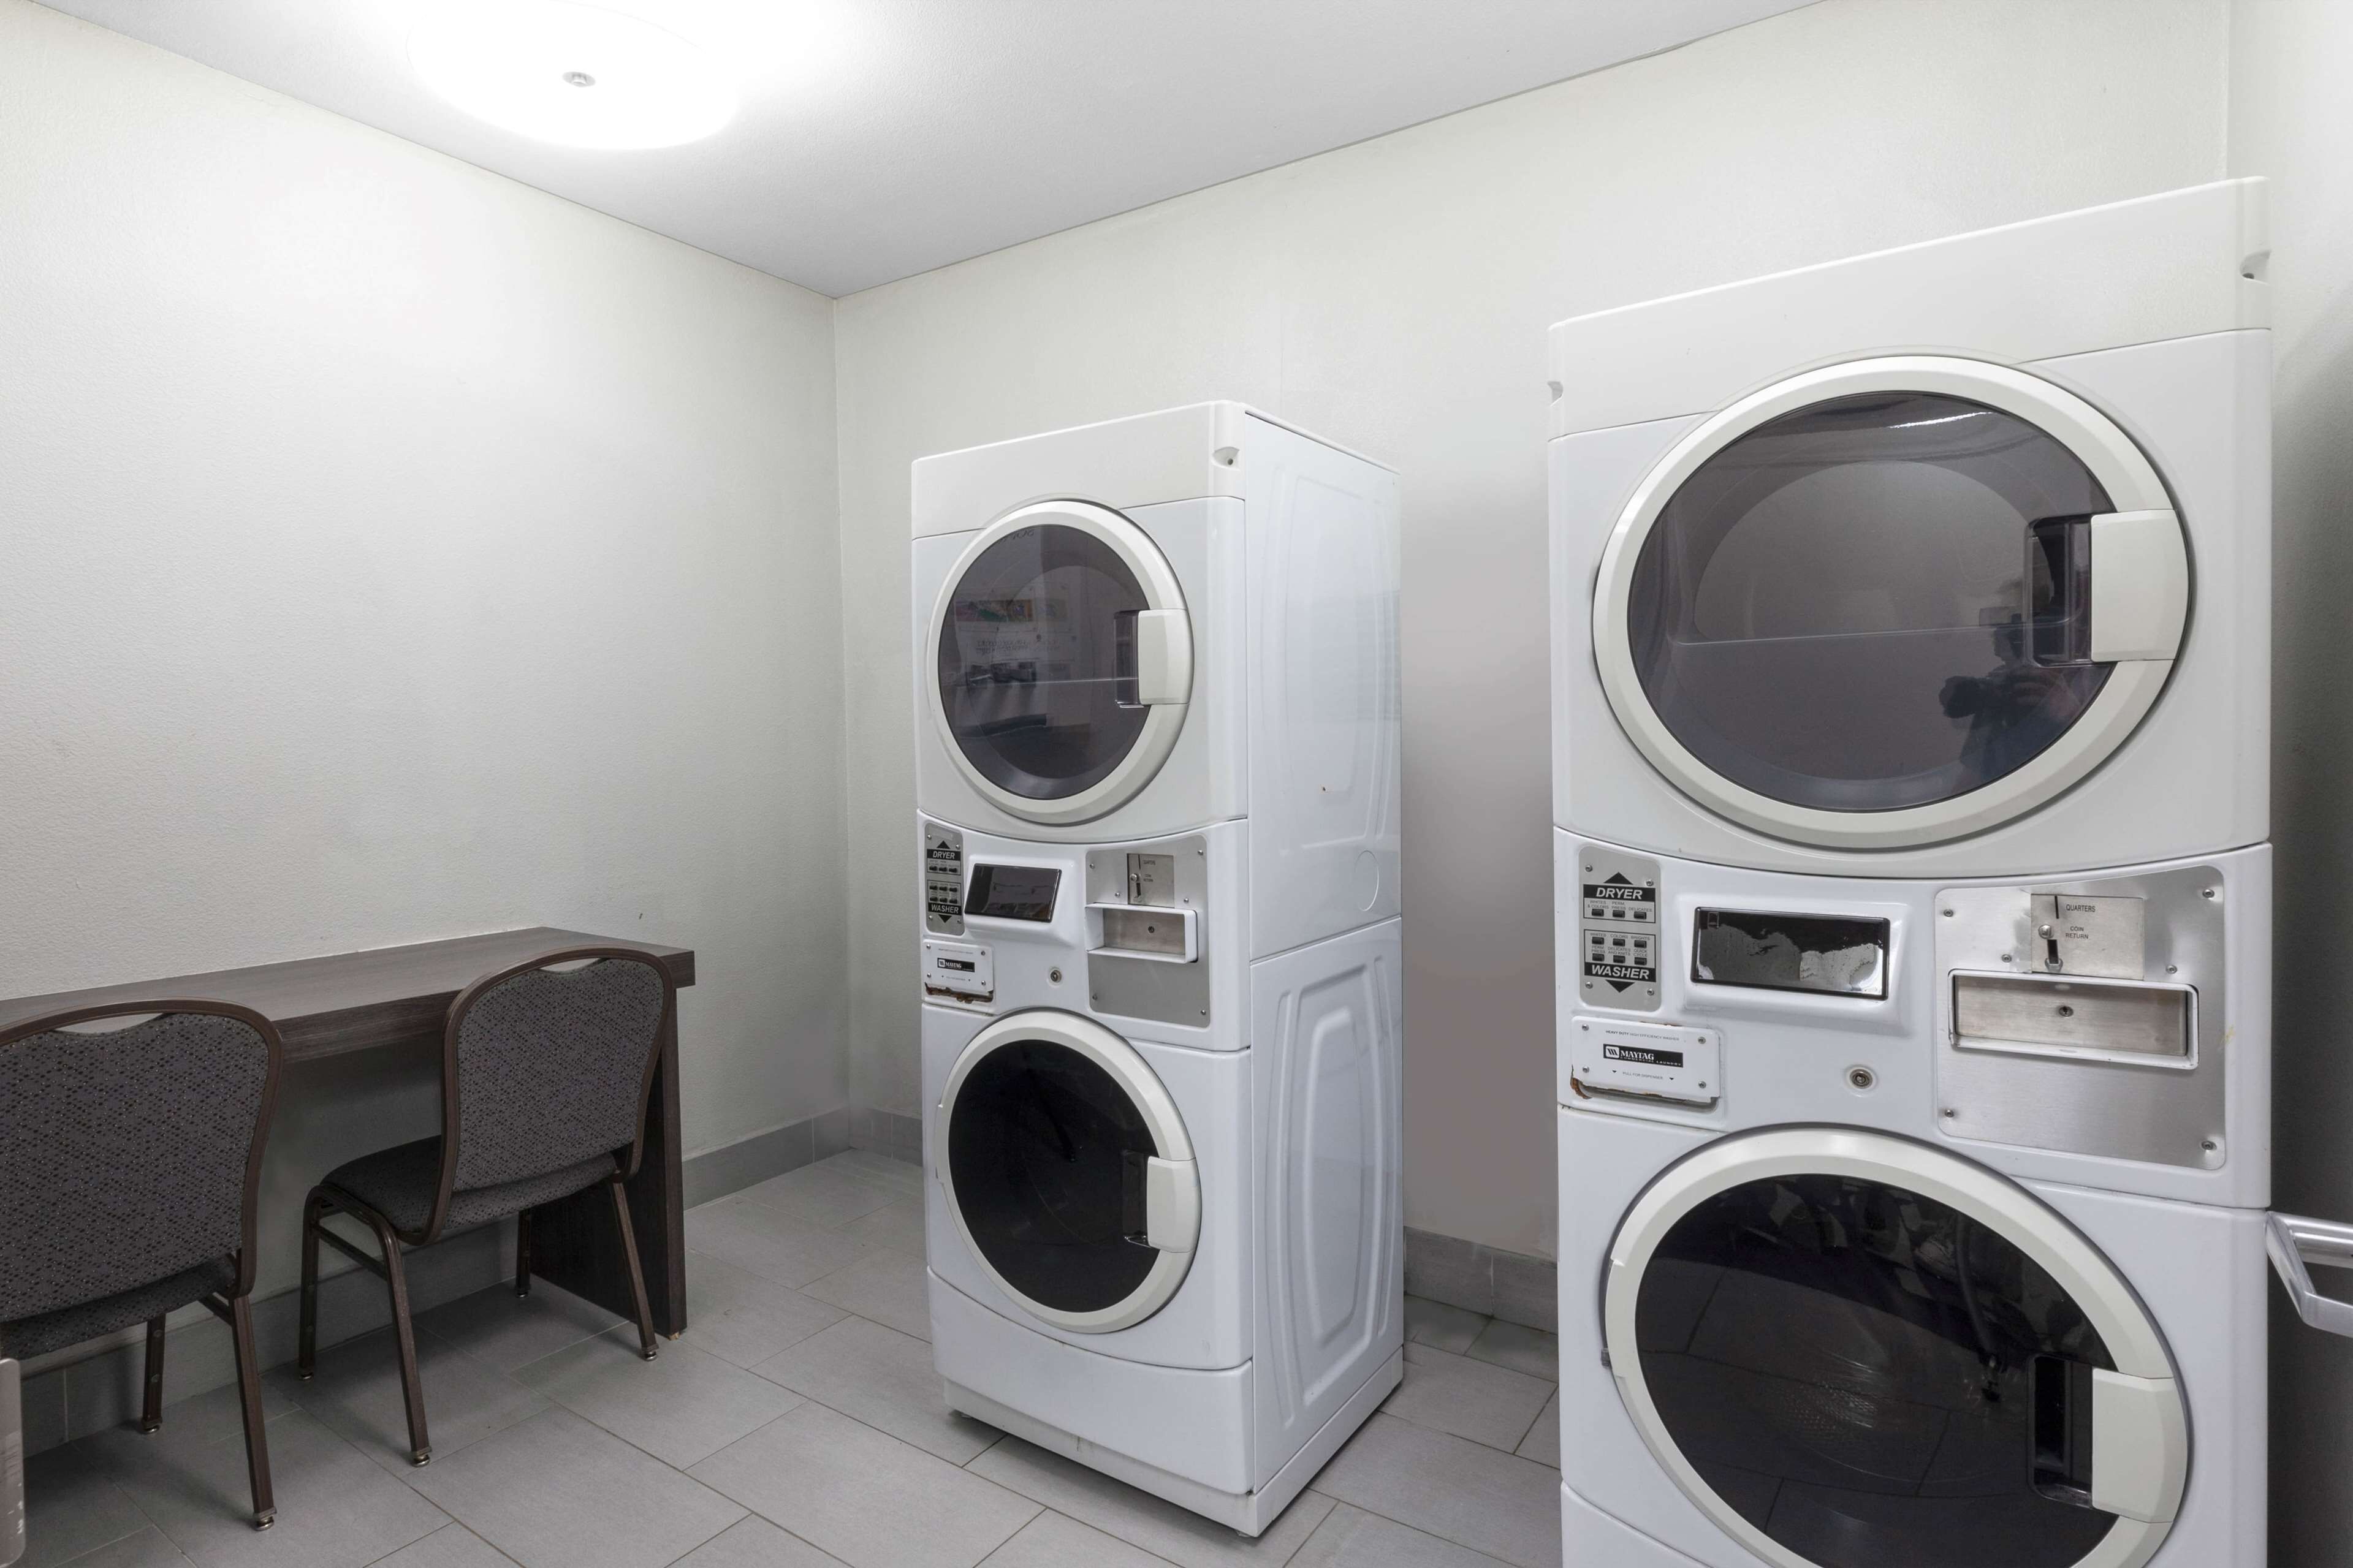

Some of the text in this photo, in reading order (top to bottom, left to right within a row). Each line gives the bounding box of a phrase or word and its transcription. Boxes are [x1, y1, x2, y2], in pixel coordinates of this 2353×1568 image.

[933, 850, 955, 859] DRYER
[1595, 887, 1643, 900] DRYER
[932, 904, 959, 914] WASHER
[2066, 904, 2096, 912] QUARTERS
[1592, 964, 1649, 980] WASHER
[1620, 1050, 1654, 1060] MAYTAG
